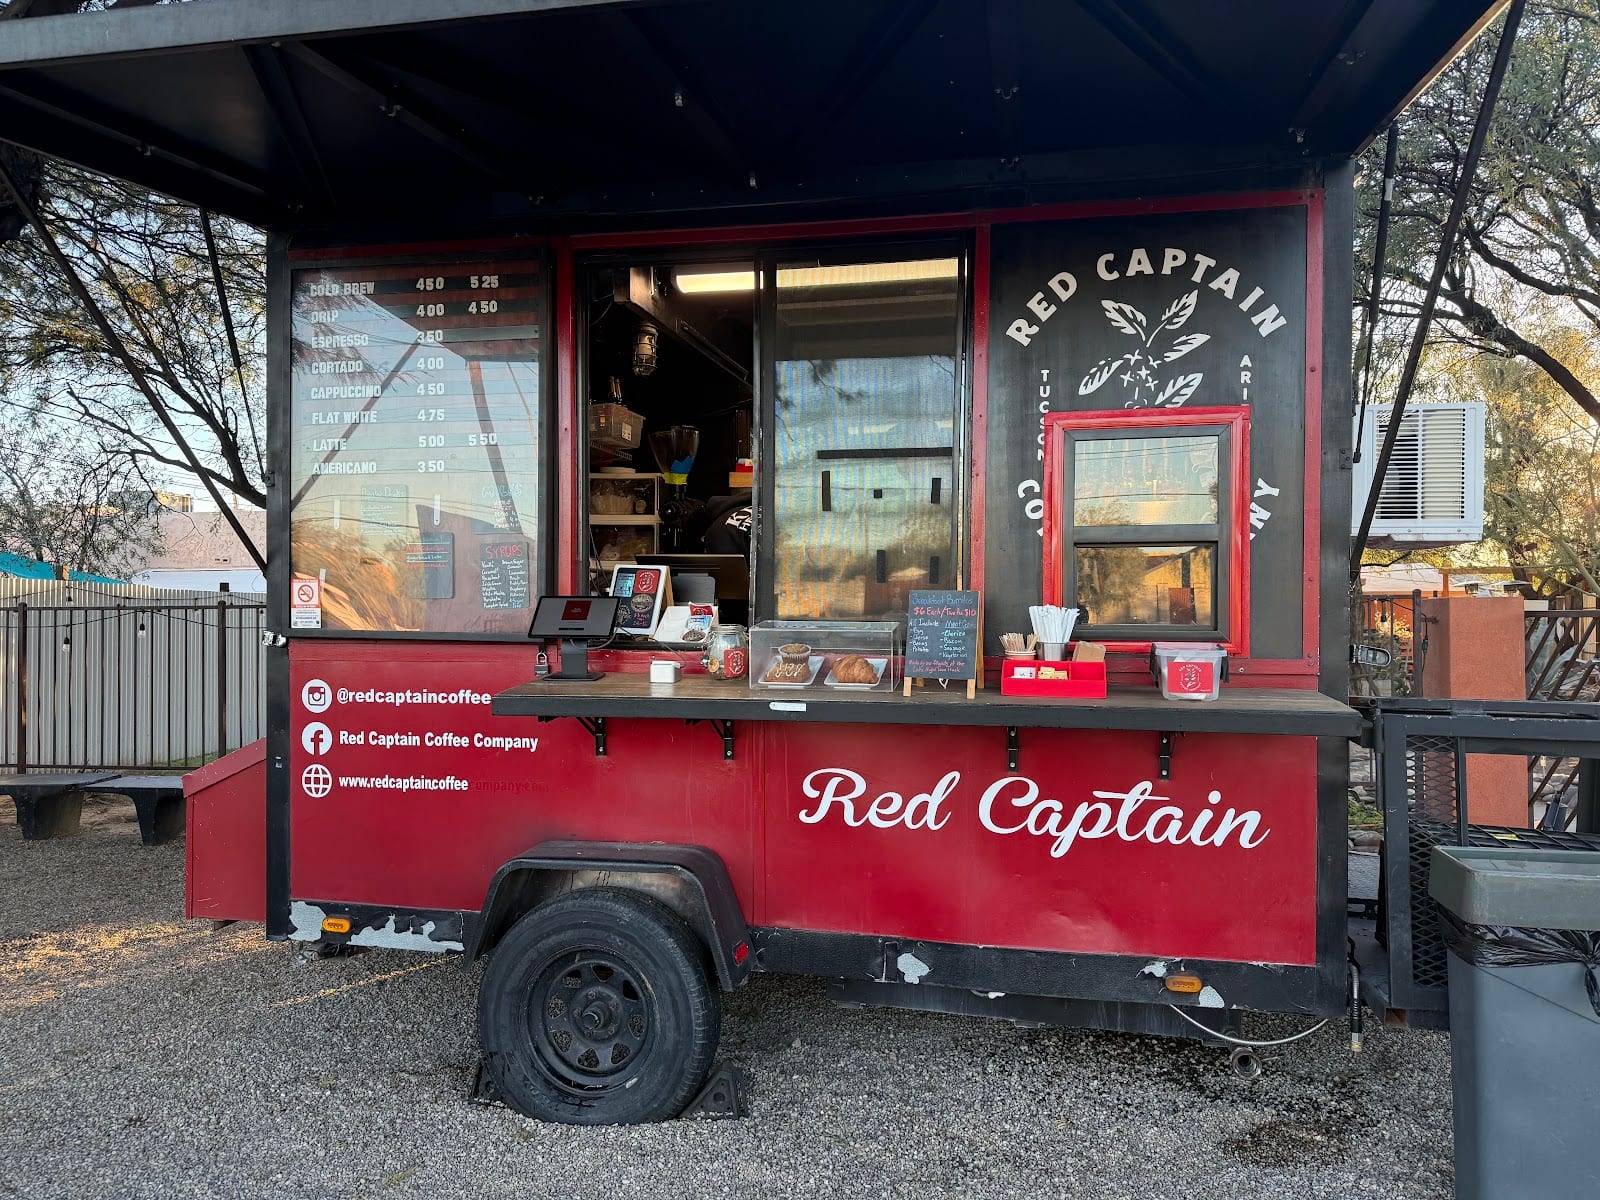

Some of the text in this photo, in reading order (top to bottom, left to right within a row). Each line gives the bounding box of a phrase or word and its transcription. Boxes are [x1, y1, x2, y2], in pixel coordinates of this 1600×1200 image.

[310, 284, 340, 297] COLD
[343, 282, 375, 295] BREW
[1005, 248, 1287, 347] RED CAPTAIN
[311, 310, 339, 324] DRIP
[311, 334, 369, 349] ESPRESSO
[311, 360, 363, 374] CORTADO
[311, 385, 381, 400] CAPPUCCINO
[312, 412, 340, 425] FLAT
[343, 411, 377, 423] WHITE
[312, 438, 347, 451] LATTE
[312, 462, 377, 475] AMERICANO
[485, 545, 523, 560] SYRUPS
[336, 688, 492, 706] @redcaptaincoffee
[339, 730, 538, 752] Red Captain Coffee Company
[799, 768, 1270, 858] Red Captain
